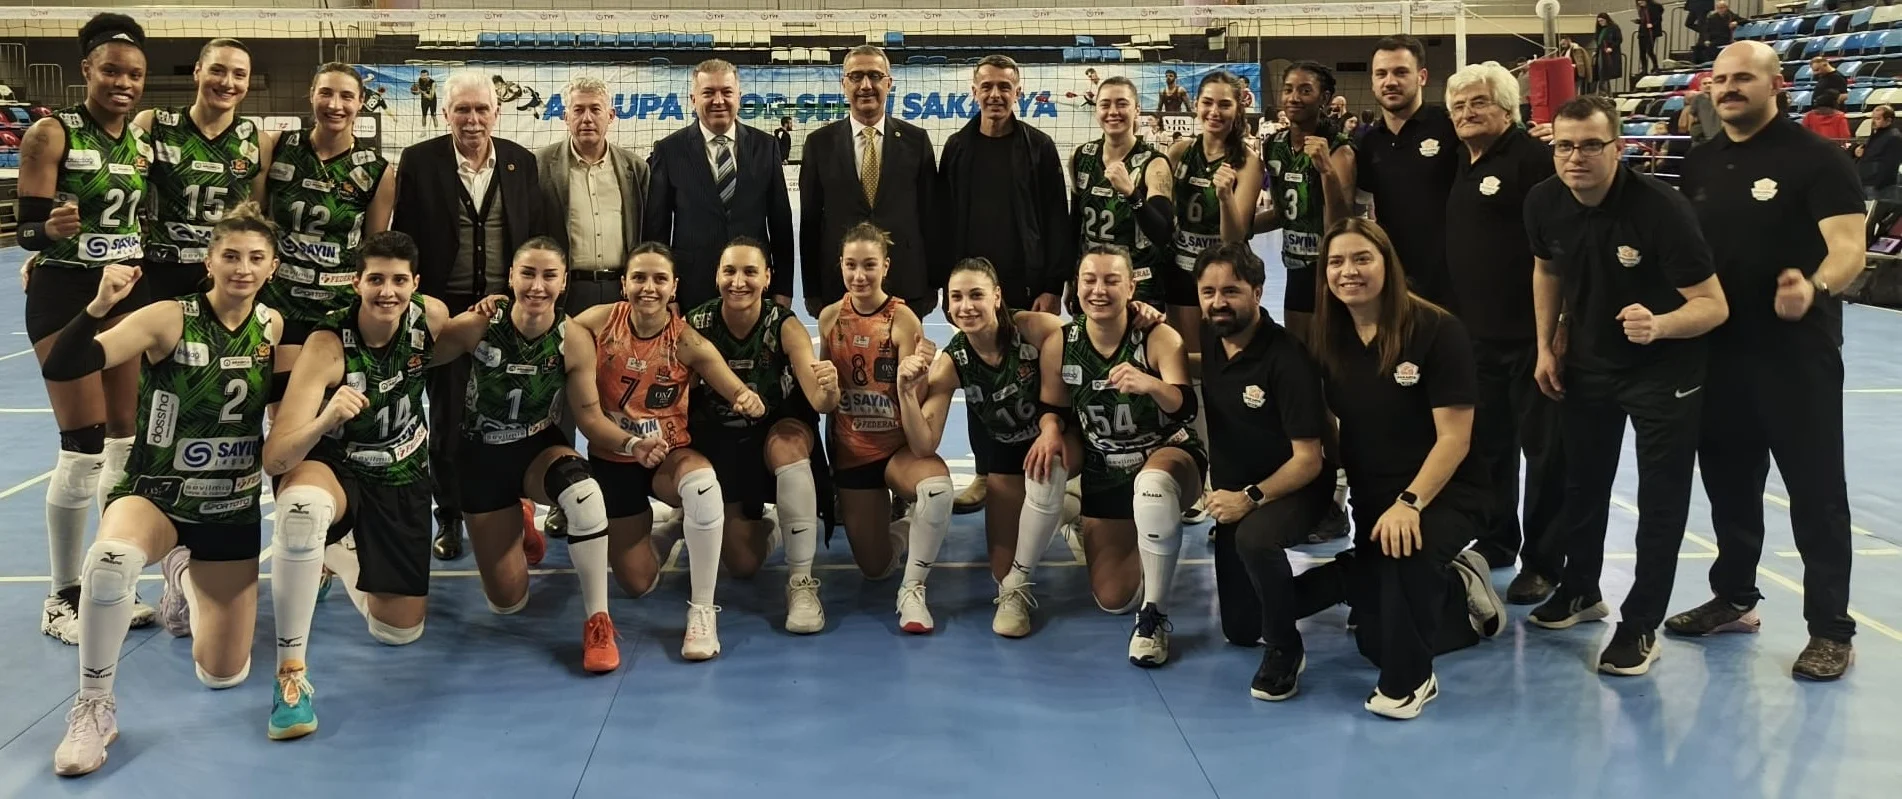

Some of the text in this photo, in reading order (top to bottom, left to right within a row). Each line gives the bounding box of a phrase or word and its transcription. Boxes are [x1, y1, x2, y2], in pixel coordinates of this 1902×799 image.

[542, 93, 685, 120] AUPA
[796, 86, 896, 123] ŞEİ
[902, 91, 1057, 119] SAKYA
[100, 188, 142, 228] 21
[183, 184, 229, 223] 15
[290, 200, 331, 234] 12
[1187, 192, 1203, 223] 6
[1285, 189, 1298, 221] 3
[1084, 206, 1115, 240] 22
[298, 242, 336, 258] SAYIN
[851, 354, 868, 387] 8
[218, 378, 248, 424] 2
[508, 388, 523, 420] 1
[619, 376, 640, 410] 7
[153, 394, 169, 444] dossha
[376, 394, 412, 439] 14
[620, 418, 658, 435] SAYIN
[861, 420, 898, 429] FEDERAL
[996, 398, 1036, 428] 16
[1087, 403, 1138, 436] 54
